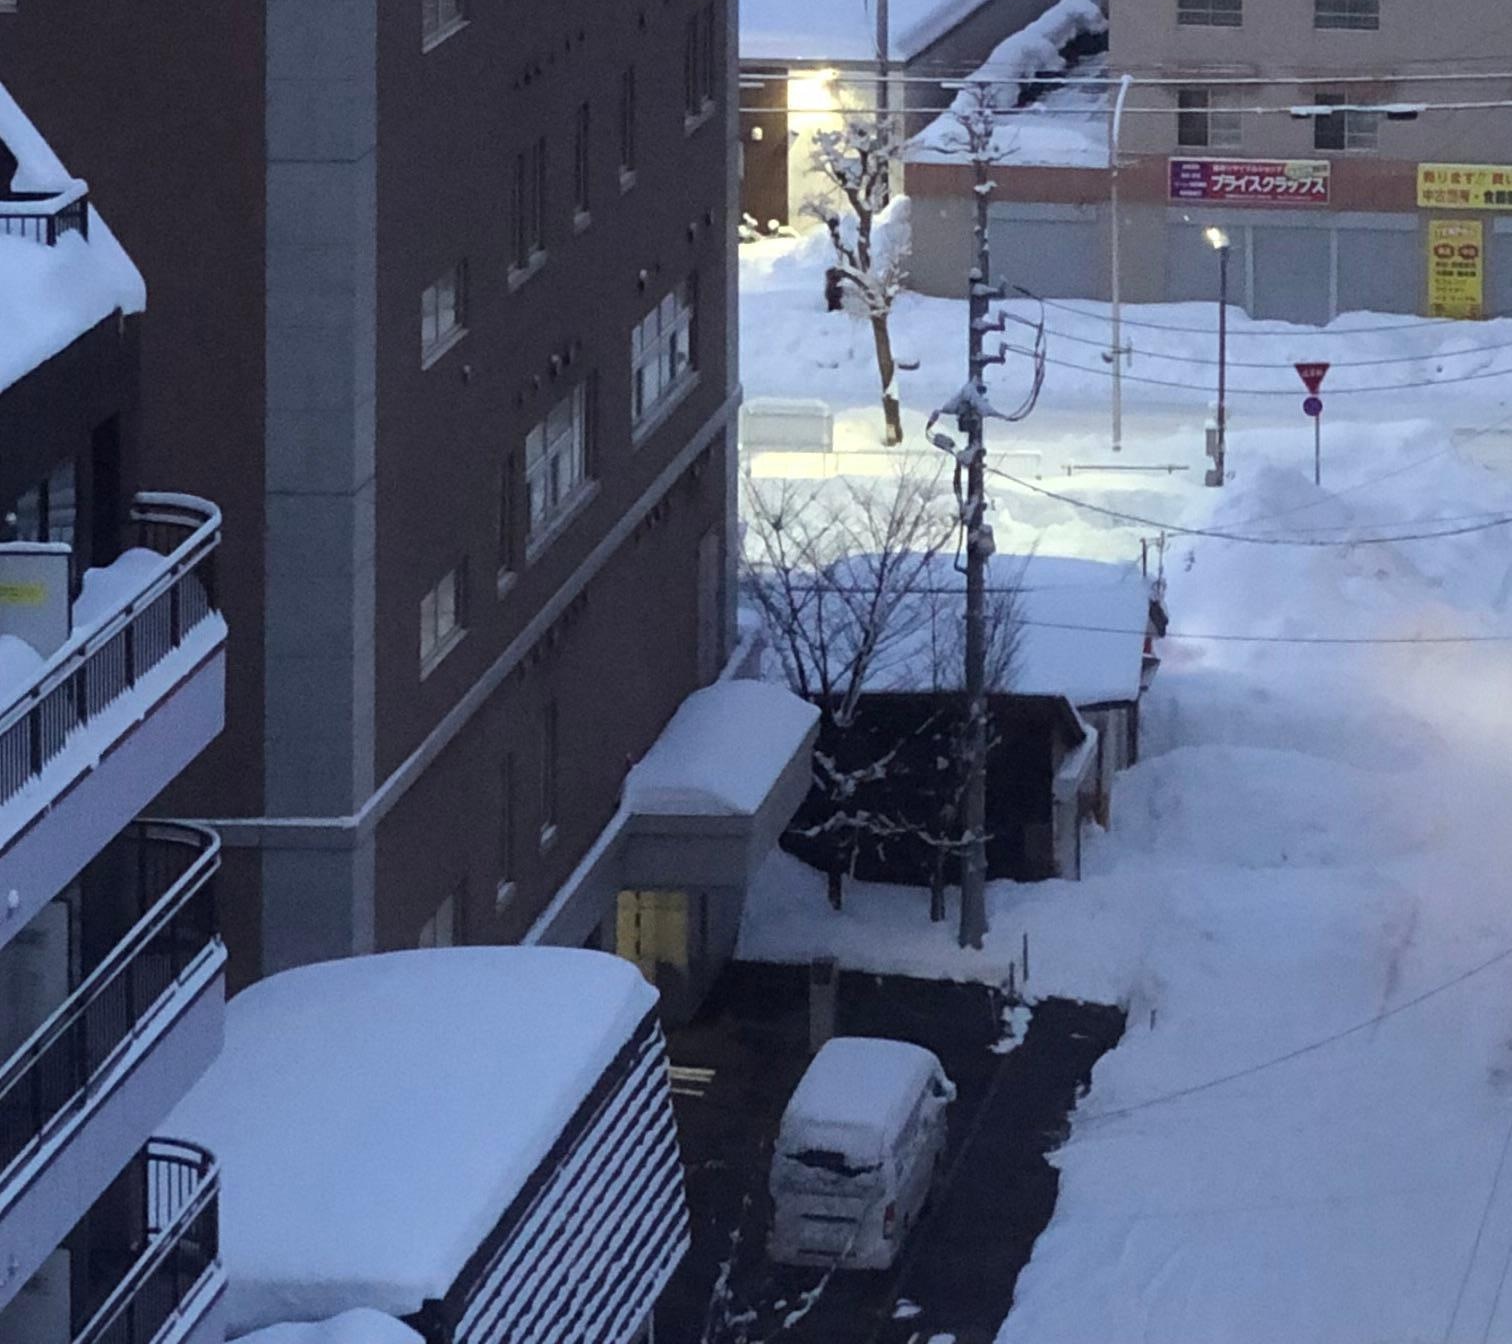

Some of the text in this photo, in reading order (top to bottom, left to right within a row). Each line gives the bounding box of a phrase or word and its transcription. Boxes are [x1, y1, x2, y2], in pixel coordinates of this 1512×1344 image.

[1211, 174, 1326, 194] プライスクラップス
